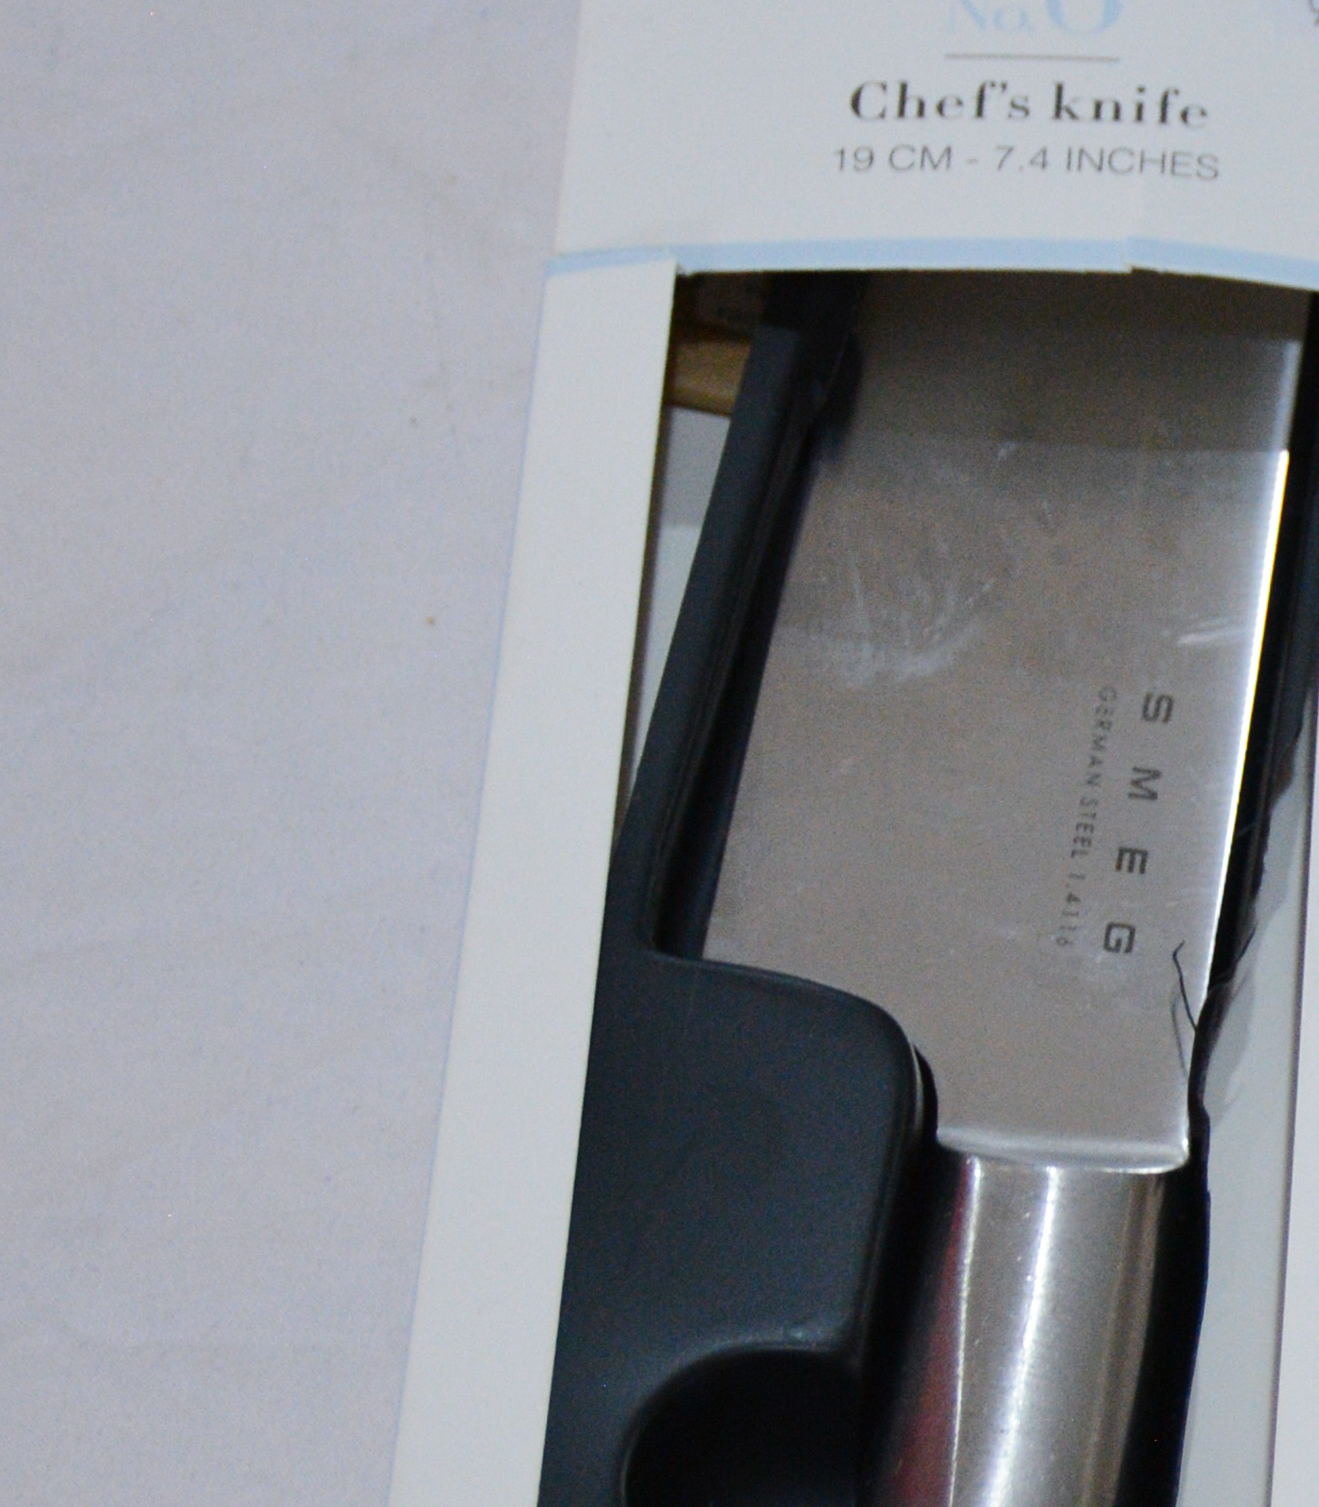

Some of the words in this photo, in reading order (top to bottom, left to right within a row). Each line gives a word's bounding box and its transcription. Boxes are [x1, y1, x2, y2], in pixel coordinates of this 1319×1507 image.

[849, 79, 1031, 122] Chef's
[1051, 81, 1210, 129] knife
[833, 145, 875, 173] 19
[888, 144, 953, 173] CM
[995, 145, 1050, 174] 7.4
[1064, 146, 1221, 182] INCHES
[1086, 684, 1118, 788] GERMAN
[1070, 795, 1100, 860] STEEL
[1101, 691, 1176, 955] SMEG
